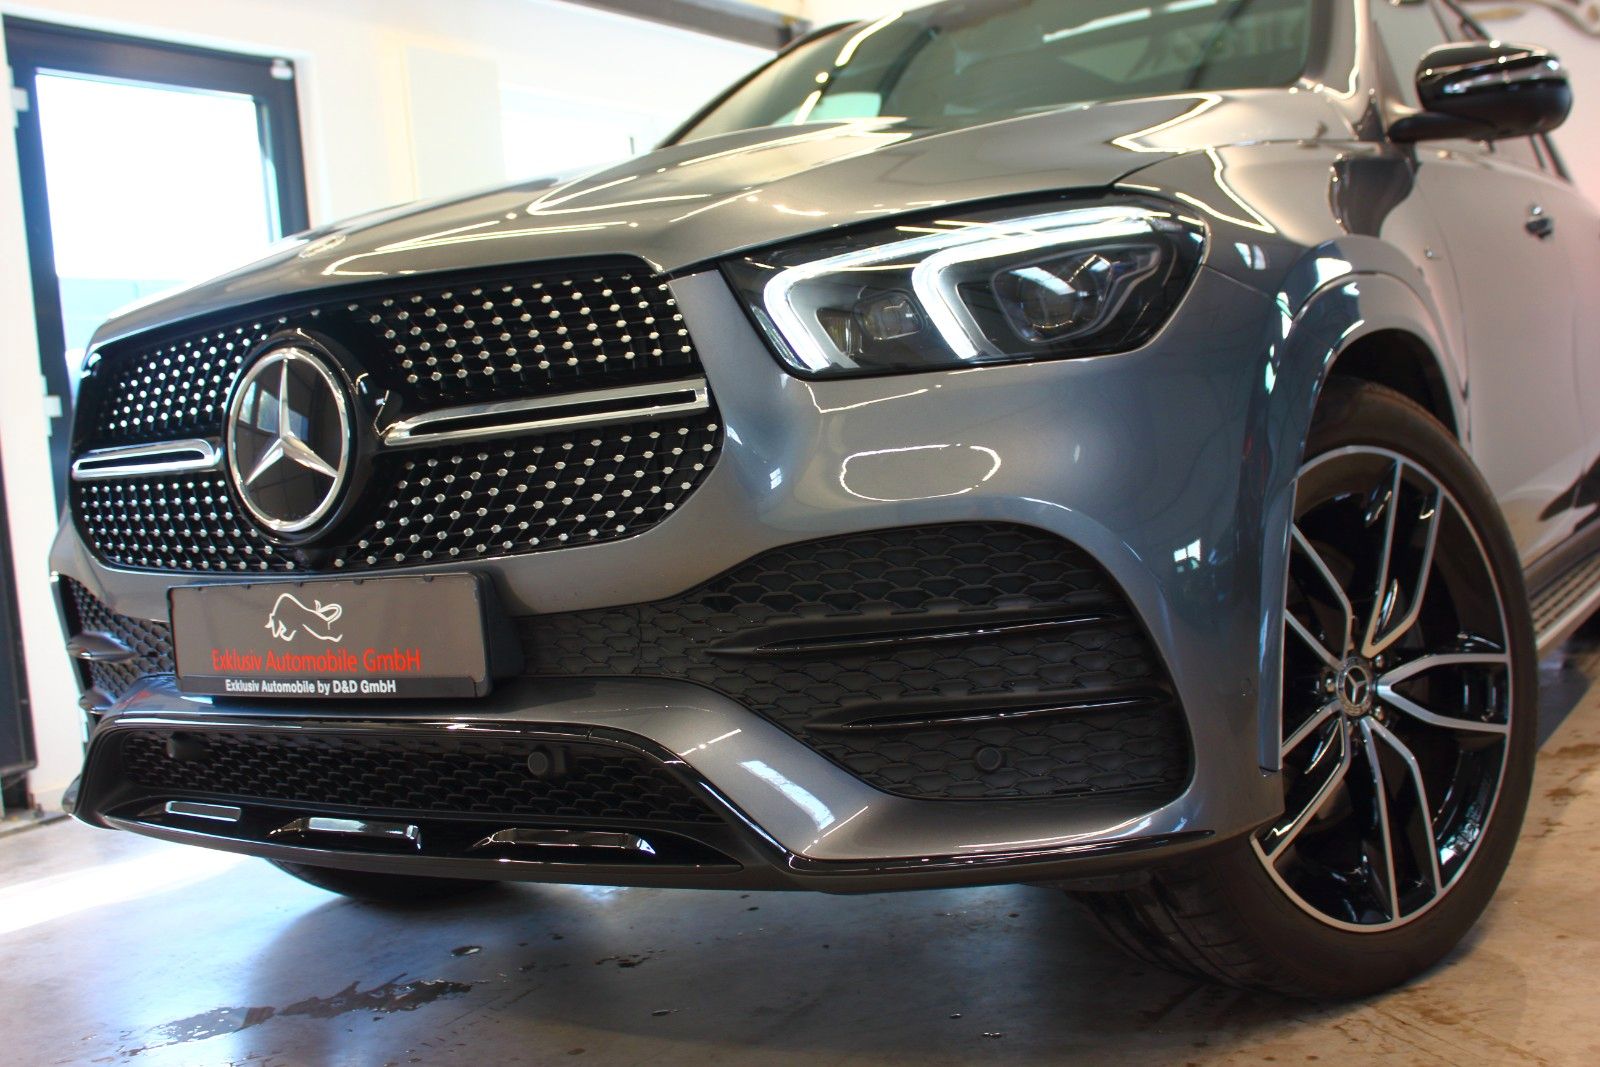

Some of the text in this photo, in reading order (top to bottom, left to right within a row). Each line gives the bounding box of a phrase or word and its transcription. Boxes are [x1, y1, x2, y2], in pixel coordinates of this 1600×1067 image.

[211, 647, 421, 672] Exklusiv Automobile GmbH
[225, 679, 397, 695] Exklusiv Automobile by D&D GmbH
